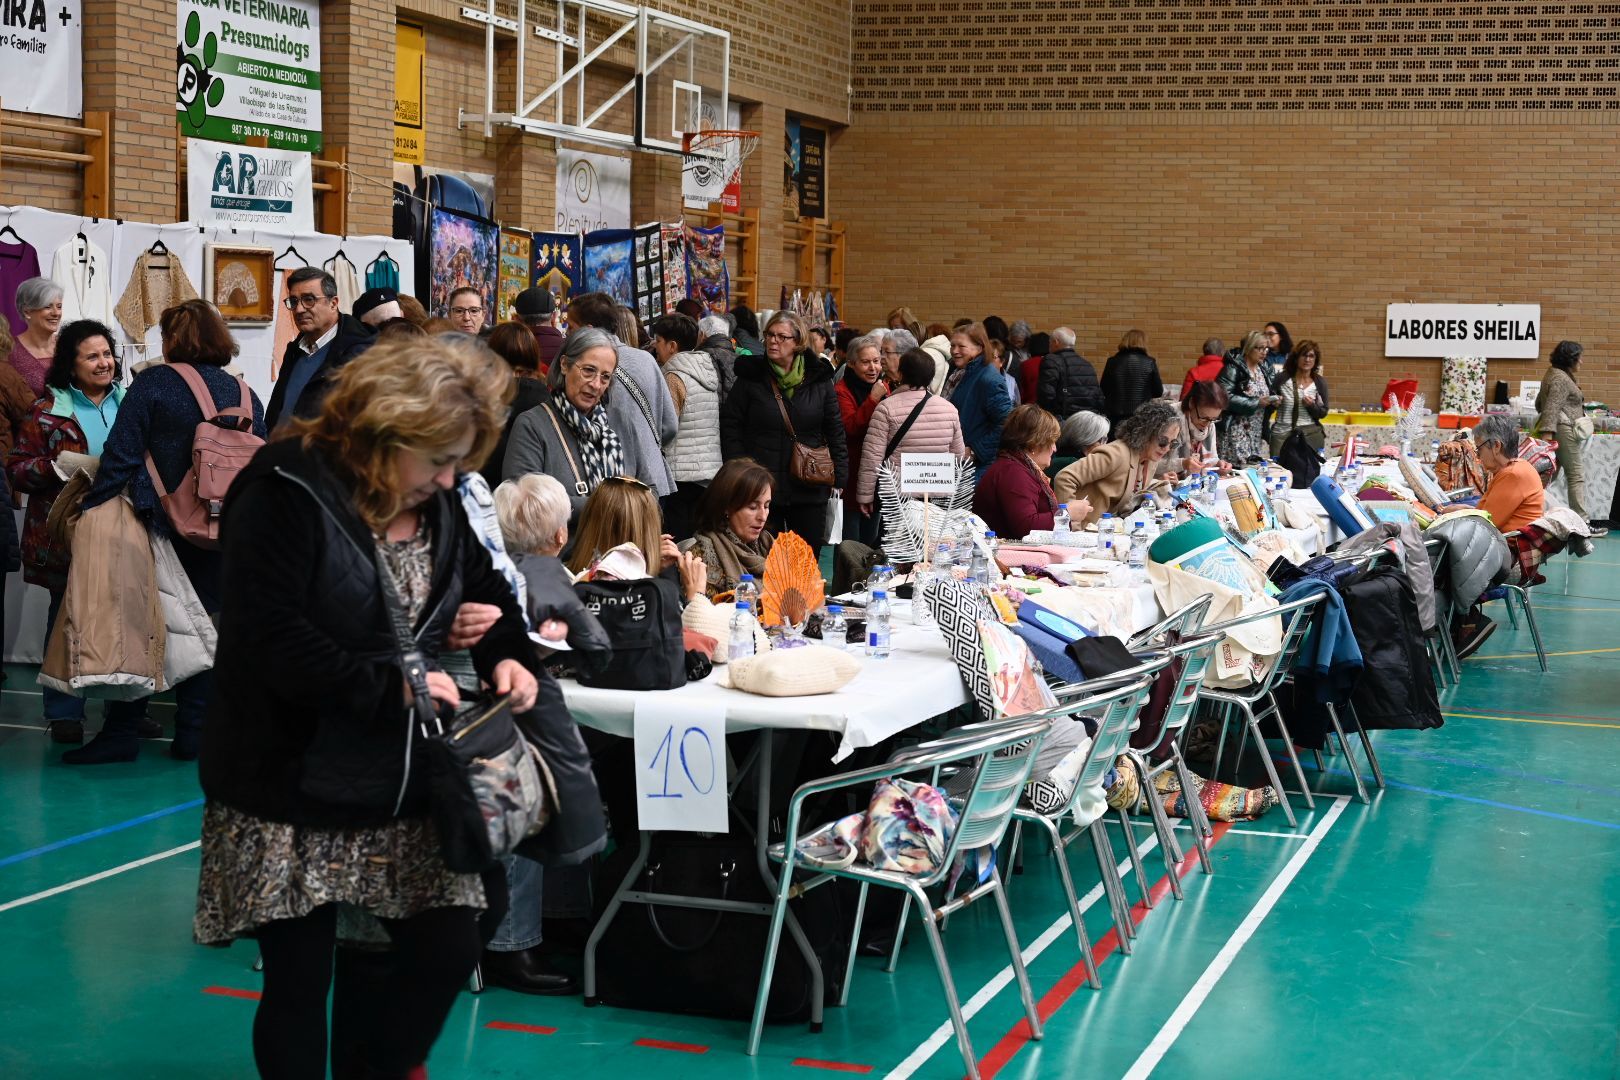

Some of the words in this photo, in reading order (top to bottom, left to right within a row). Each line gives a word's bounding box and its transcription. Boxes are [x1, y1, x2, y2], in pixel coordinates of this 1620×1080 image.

[225, 0, 311, 30] VETERINARIA
[11, 34, 47, 54] familiar
[221, 21, 310, 62] Presumidogs
[237, 62, 268, 78] ABIERTO
[269, 68, 275, 78] A
[275, 69, 308, 85] MEDIODÍA
[271, 90, 278, 99] de
[269, 102, 275, 110] de
[277, 102, 285, 111] las
[231, 124, 242, 135] 987
[244, 126, 252, 136] 30
[253, 127, 261, 137] 74
[262, 128, 270, 138] 29
[274, 130, 284, 140] 639
[285, 132, 291, 142] 14
[292, 133, 299, 143] 70
[300, 135, 308, 144] 19
[213, 196, 225, 206] más
[1388, 319, 1468, 340] LABORES
[1473, 319, 1537, 341] SHEILA
[647, 725, 714, 798] 10
